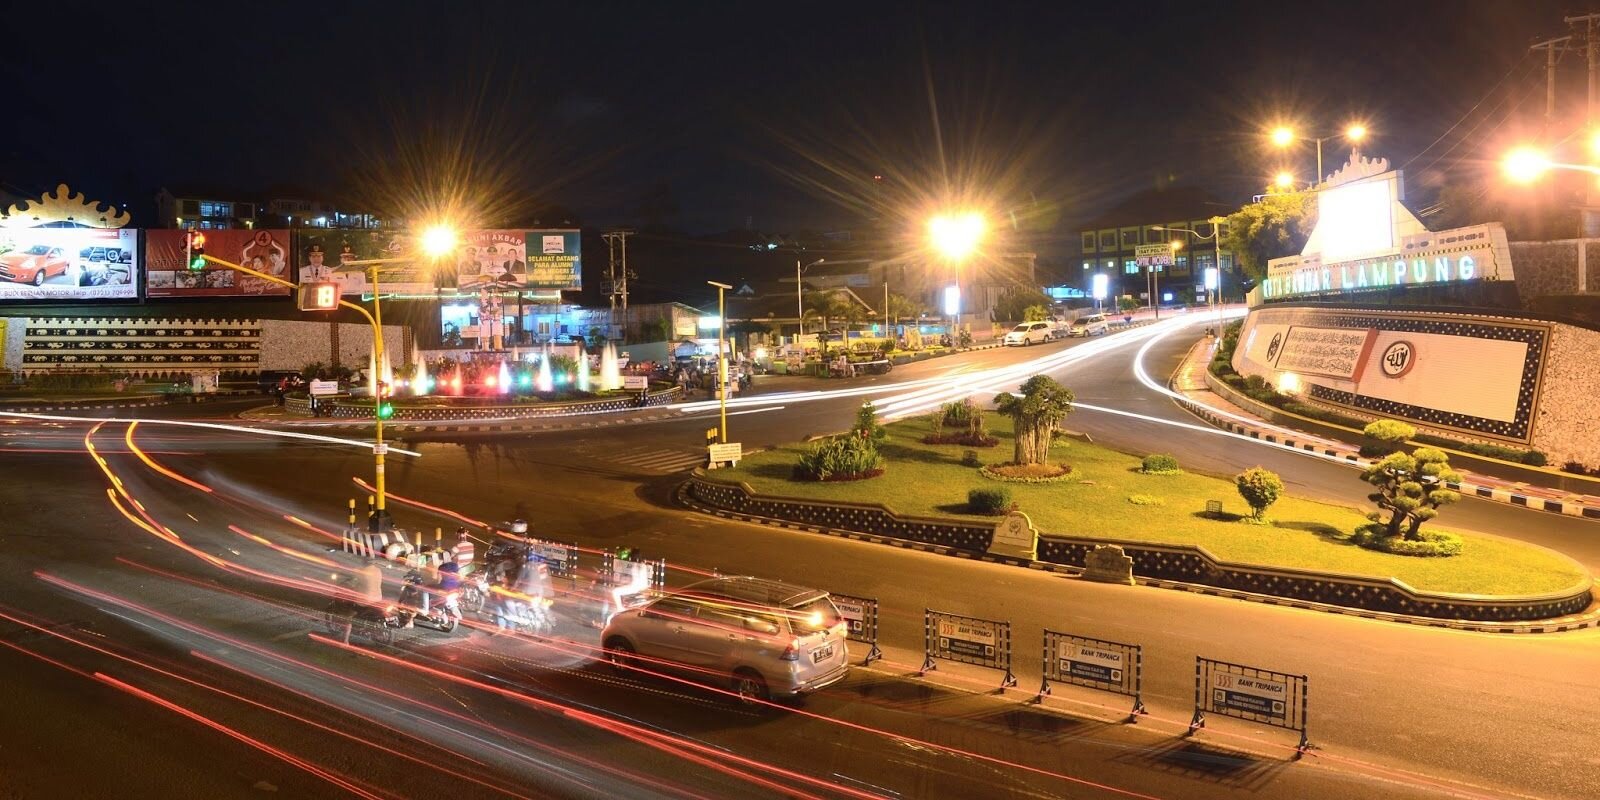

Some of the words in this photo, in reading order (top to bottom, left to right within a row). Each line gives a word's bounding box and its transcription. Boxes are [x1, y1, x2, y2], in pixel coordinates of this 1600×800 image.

[259, 233, 267, 242] 4
[492, 234, 522, 246] AKBAR
[1341, 256, 1474, 289] LAMPUNG
[1081, 649, 1095, 657] BANK
[1096, 652, 1120, 661] TRIPANCA
[1238, 679, 1254, 688] BANK
[1255, 682, 1283, 693] TRIPANCA
